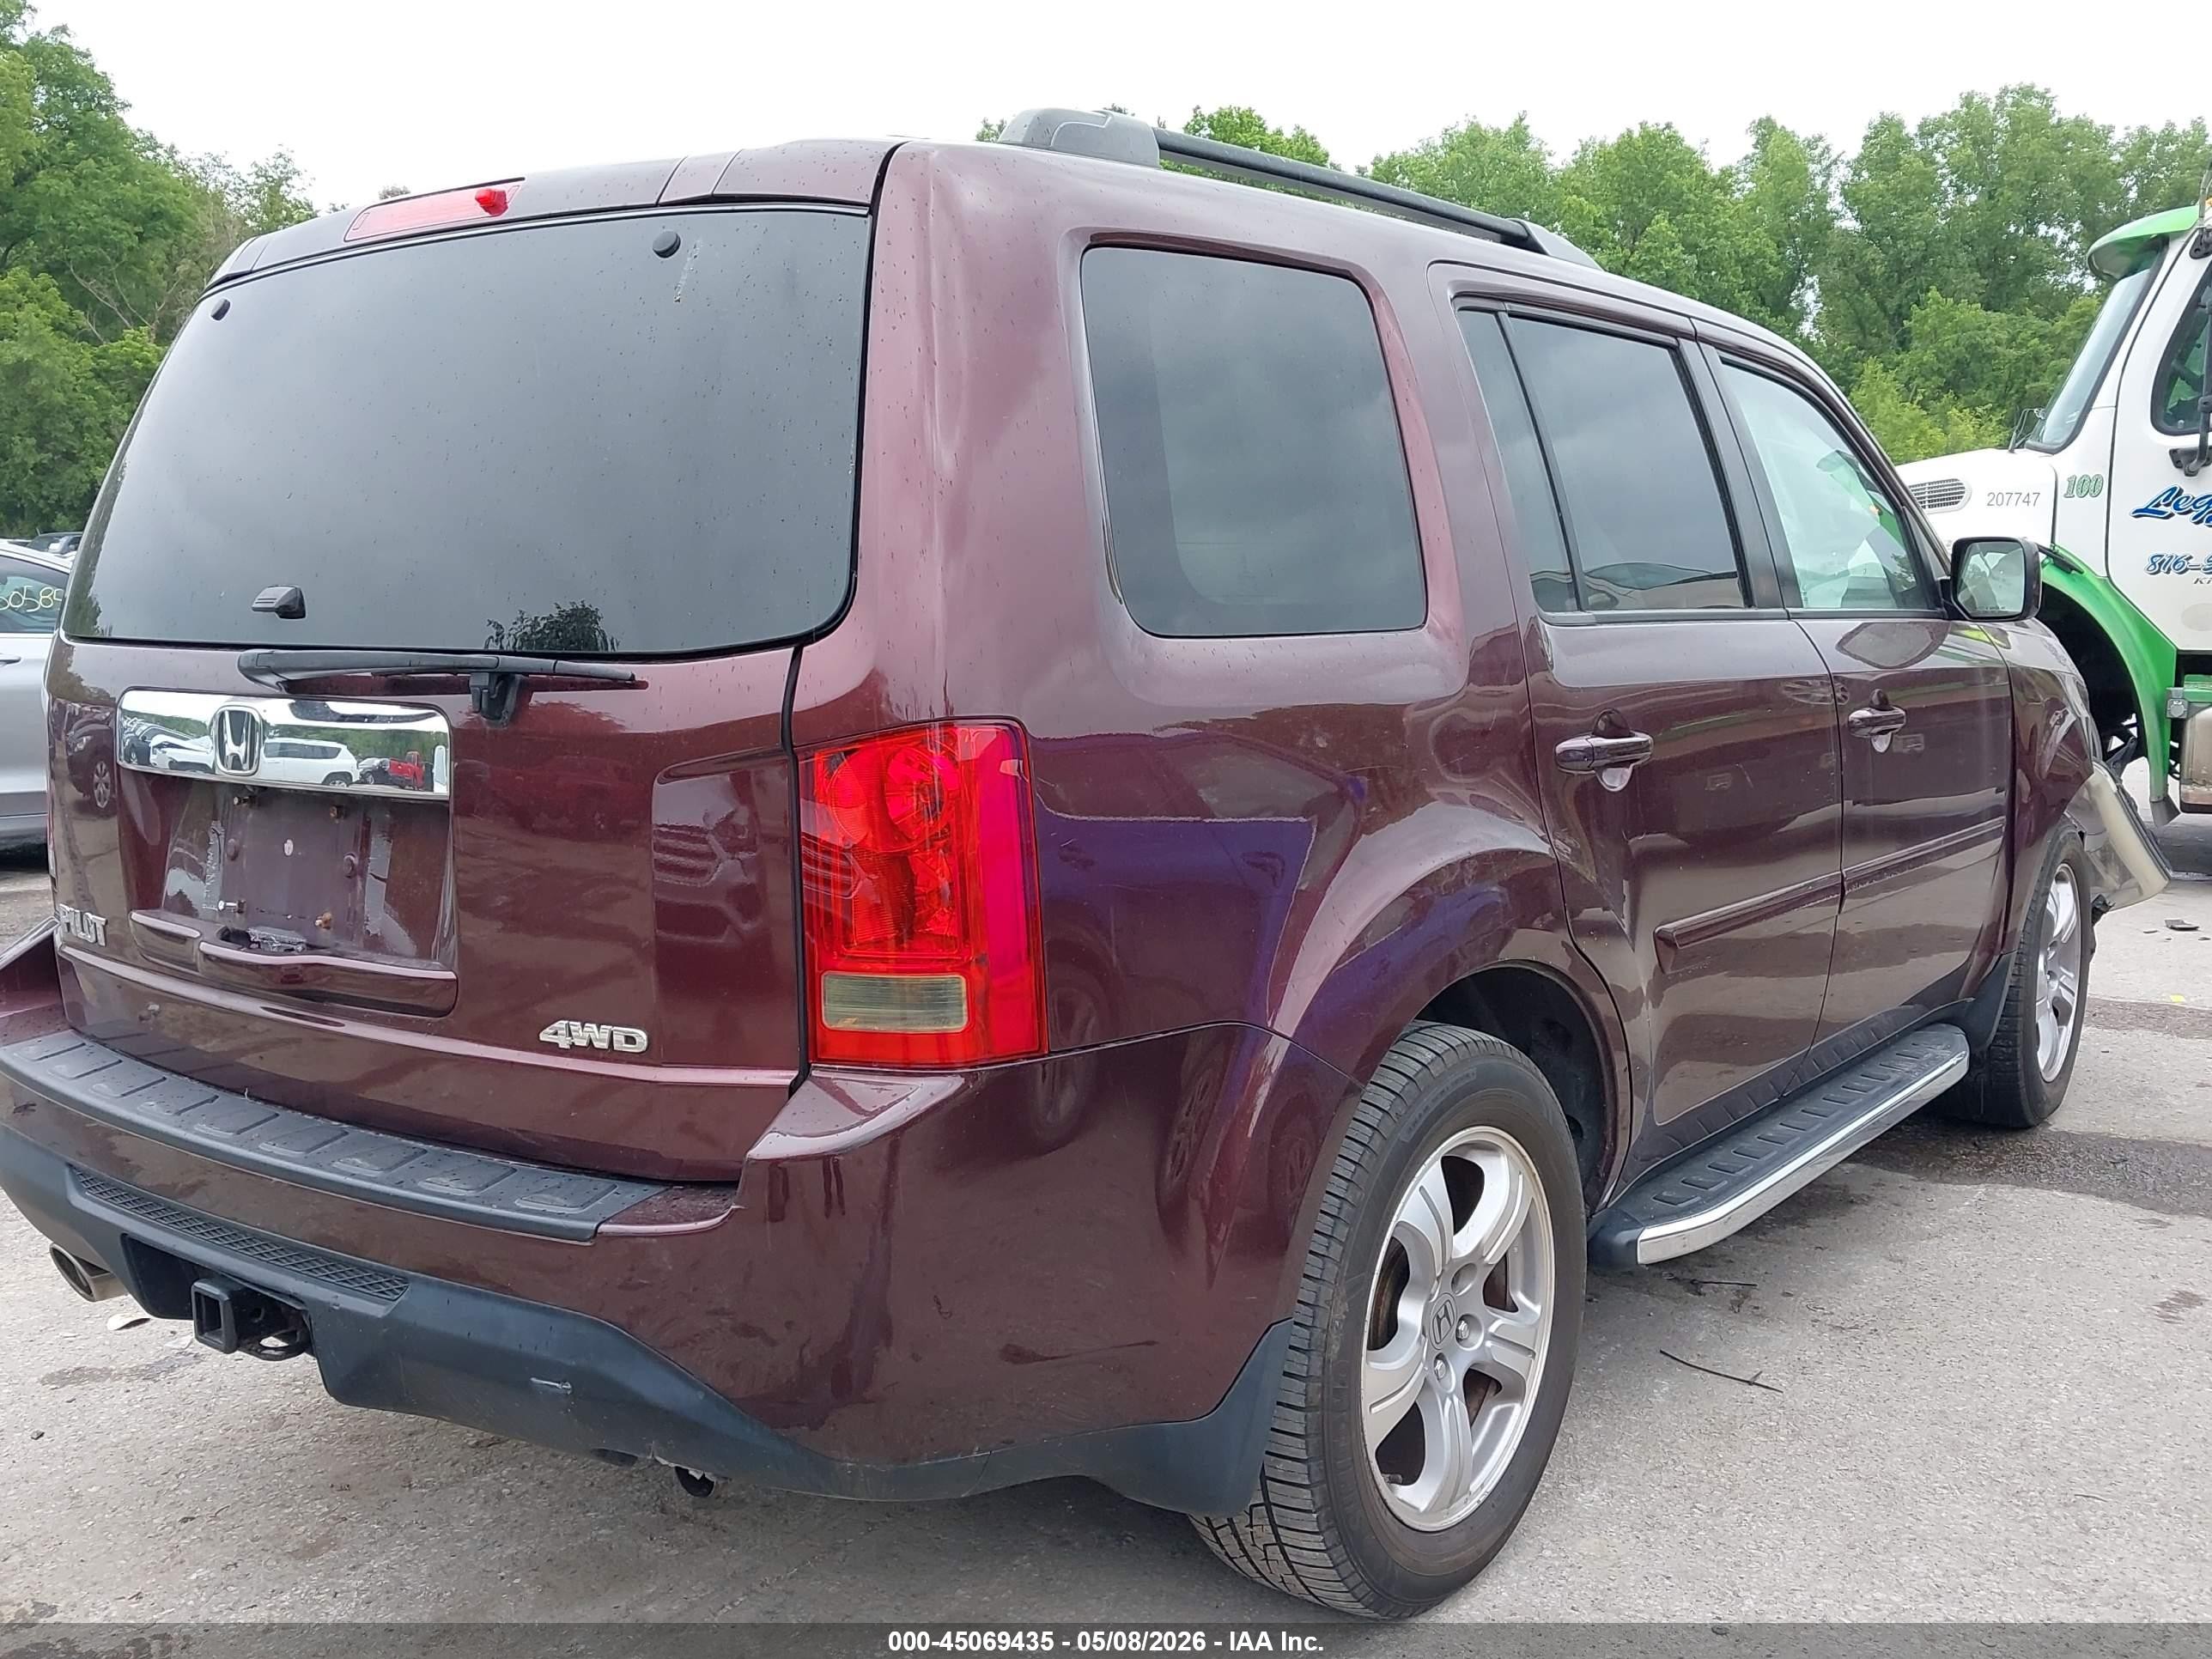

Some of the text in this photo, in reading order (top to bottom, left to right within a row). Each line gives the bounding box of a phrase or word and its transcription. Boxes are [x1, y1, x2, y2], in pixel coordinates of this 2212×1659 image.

[1986, 491, 2041, 507] 207747
[2063, 473, 2104, 499] 100
[59, 903, 108, 946] PILOT
[538, 1019, 649, 1054] 4WD
